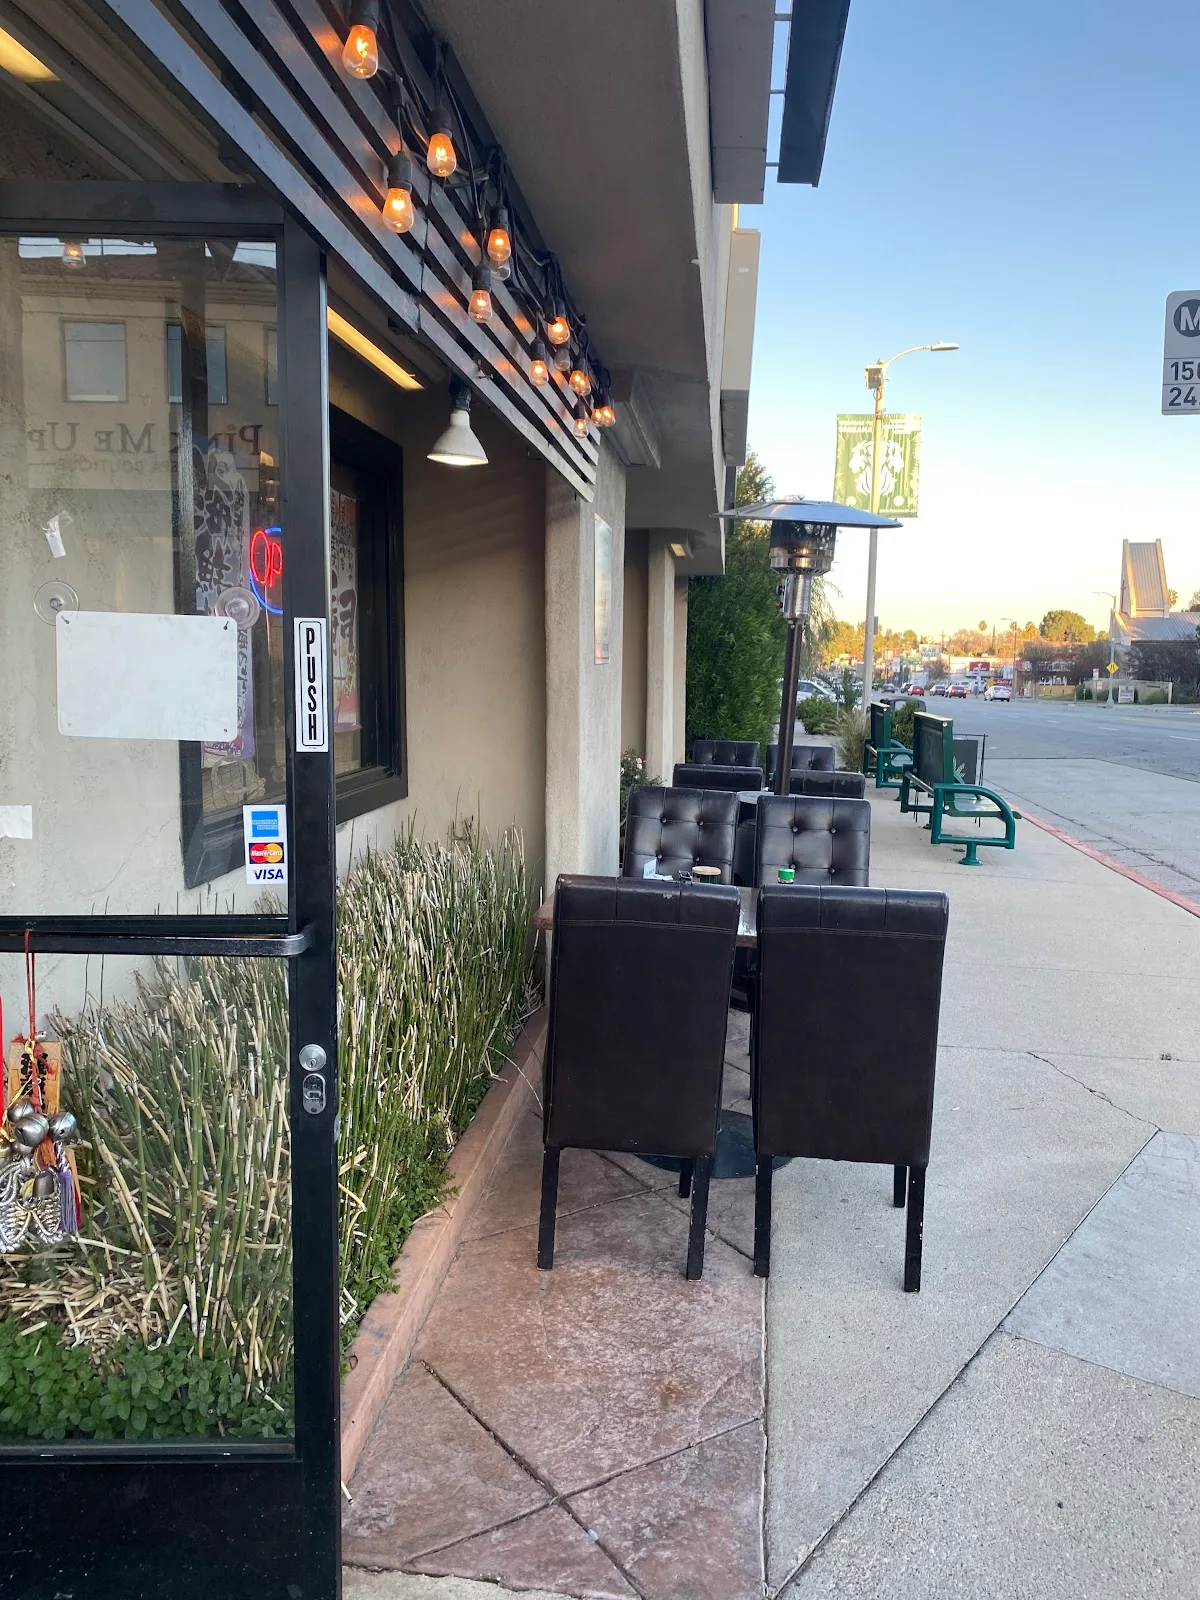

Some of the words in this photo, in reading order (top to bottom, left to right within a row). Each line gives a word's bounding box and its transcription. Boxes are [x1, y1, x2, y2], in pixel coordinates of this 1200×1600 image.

[1180, 306, 1200, 331] M
[1170, 361, 1200, 381] 15
[1168, 386, 1200, 406] 24
[305, 627, 318, 741] PUSH
[253, 868, 284, 880] VISA
